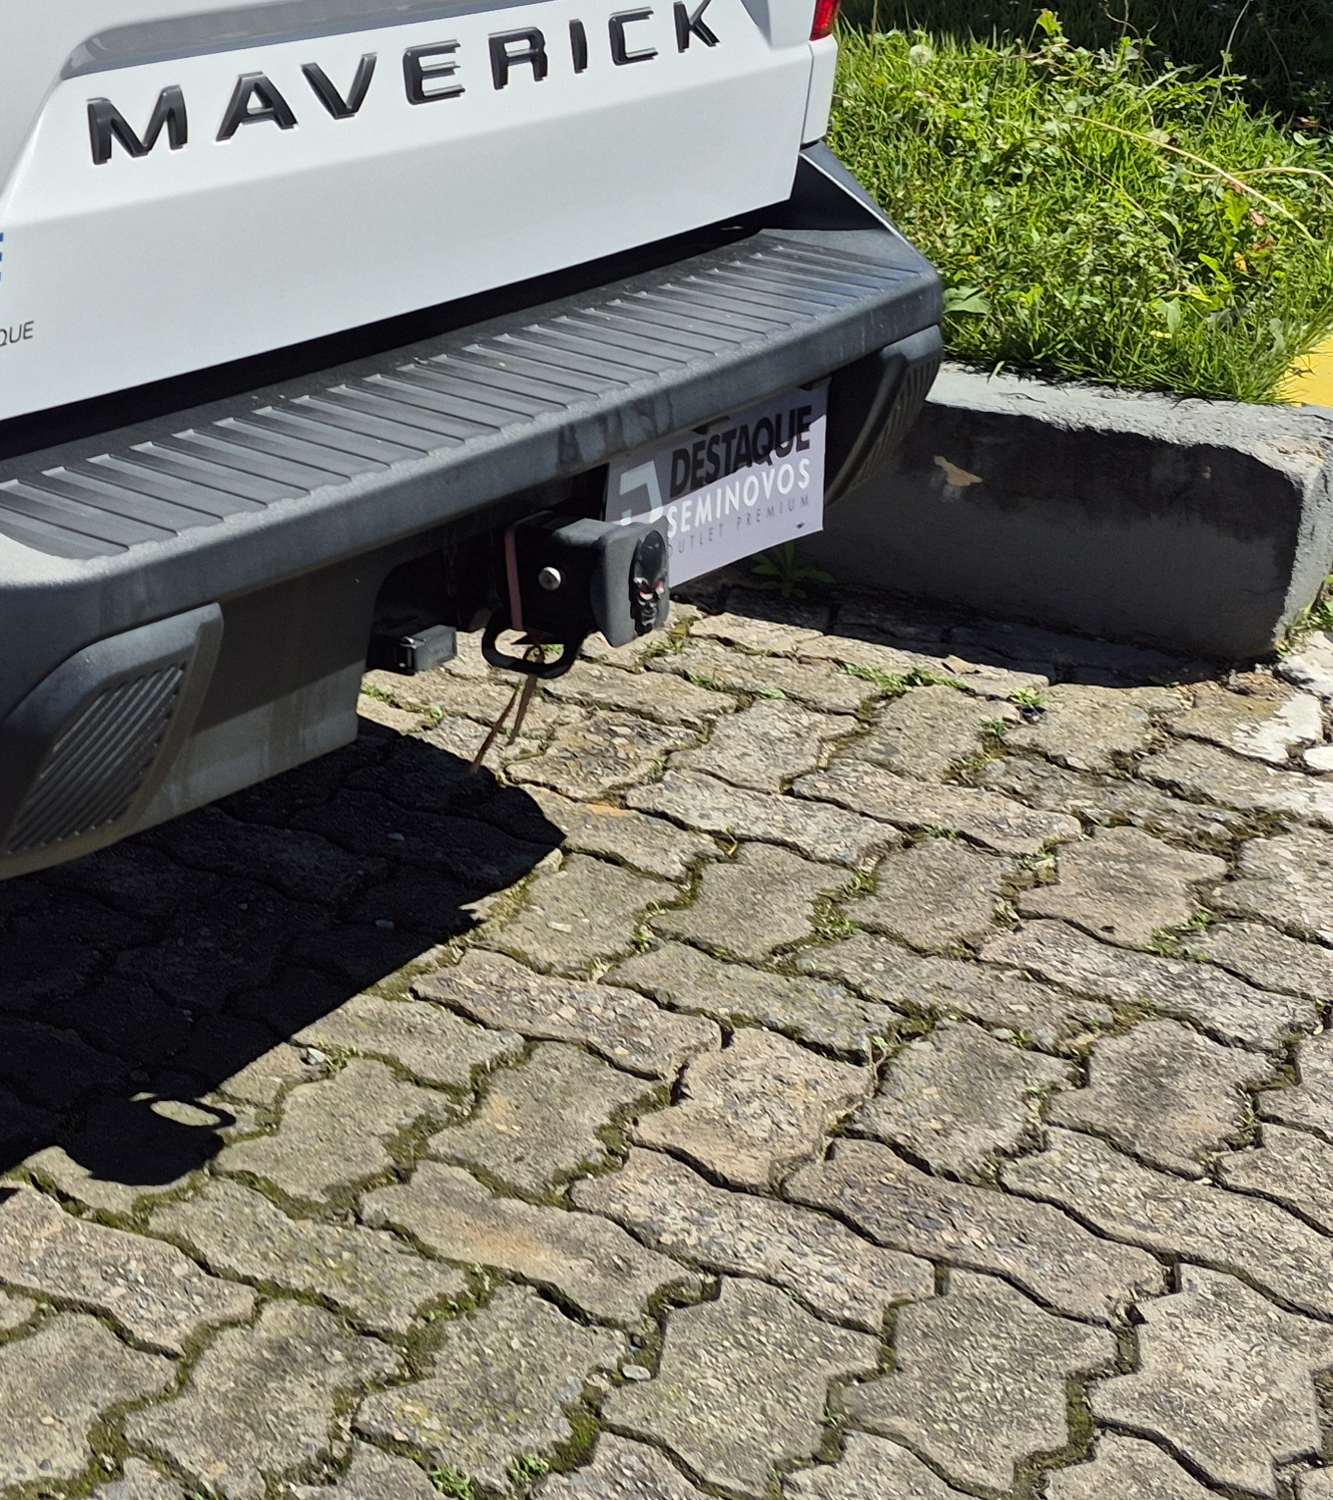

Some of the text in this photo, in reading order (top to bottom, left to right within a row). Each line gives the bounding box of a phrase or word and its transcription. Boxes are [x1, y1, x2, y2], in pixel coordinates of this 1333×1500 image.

[669, 404, 813, 499] DESTAQUE
[667, 457, 811, 539] SEMINOVOS
[735, 495, 810, 531] PREMIUM
